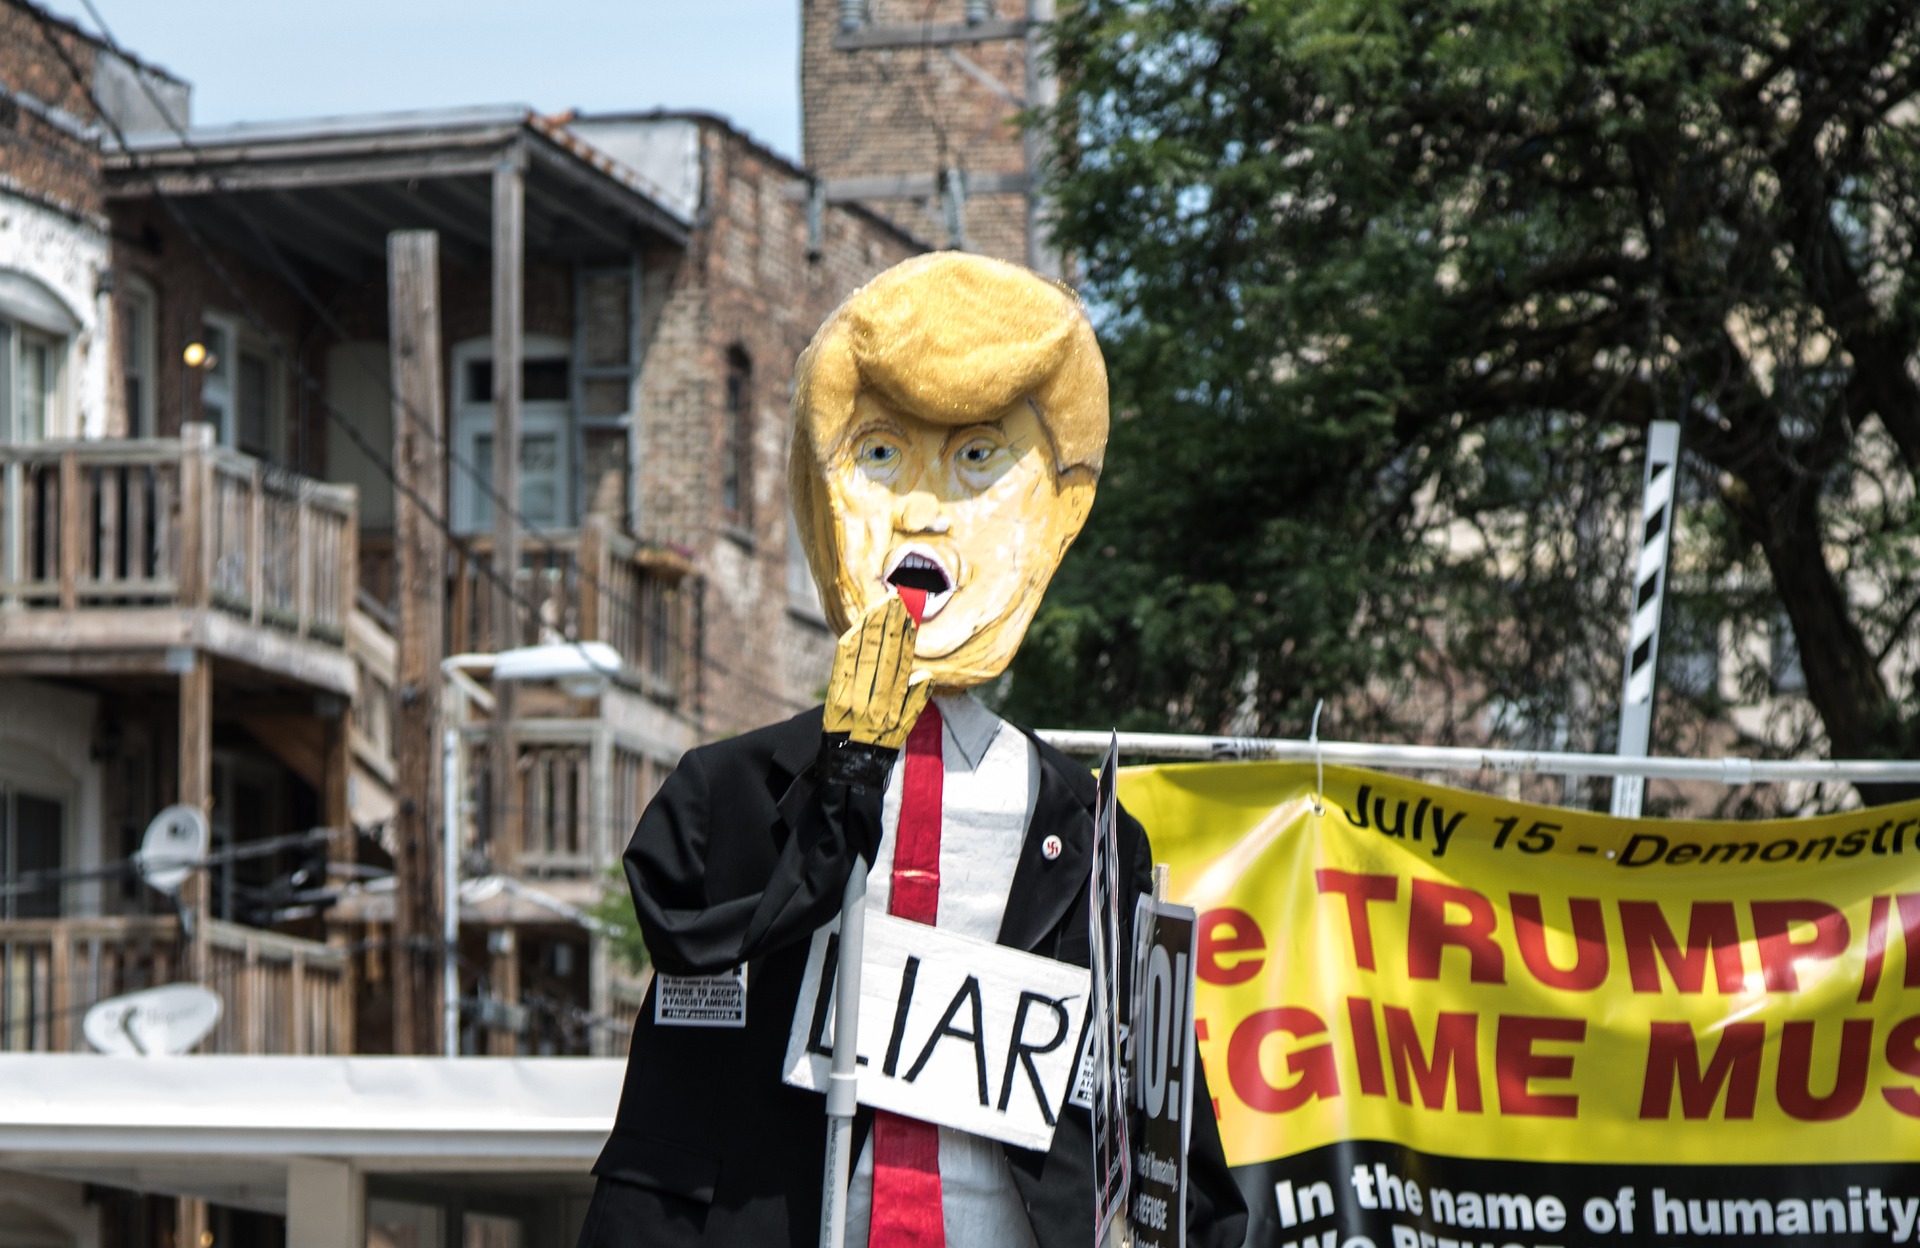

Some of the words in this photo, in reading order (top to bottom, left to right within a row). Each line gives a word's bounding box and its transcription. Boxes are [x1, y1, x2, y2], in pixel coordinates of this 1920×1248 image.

[1344, 784, 1469, 858] July
[1493, 815, 1563, 856] 15
[663, 987, 694, 997] REFUSE
[698, 988, 708, 997] TO
[710, 988, 742, 998] ACCEPT
[669, 997, 703, 1007] FASCIST
[704, 998, 742, 1008] AMERICA
[807, 931, 1074, 1127] LIAR
[1195, 996, 1588, 1119] GIME
[1275, 1179, 1335, 1229] In
[1351, 1162, 1424, 1217] the
[1430, 1186, 1567, 1232] name
[1583, 1186, 1636, 1235] of
[1652, 1186, 1920, 1243] humanity
